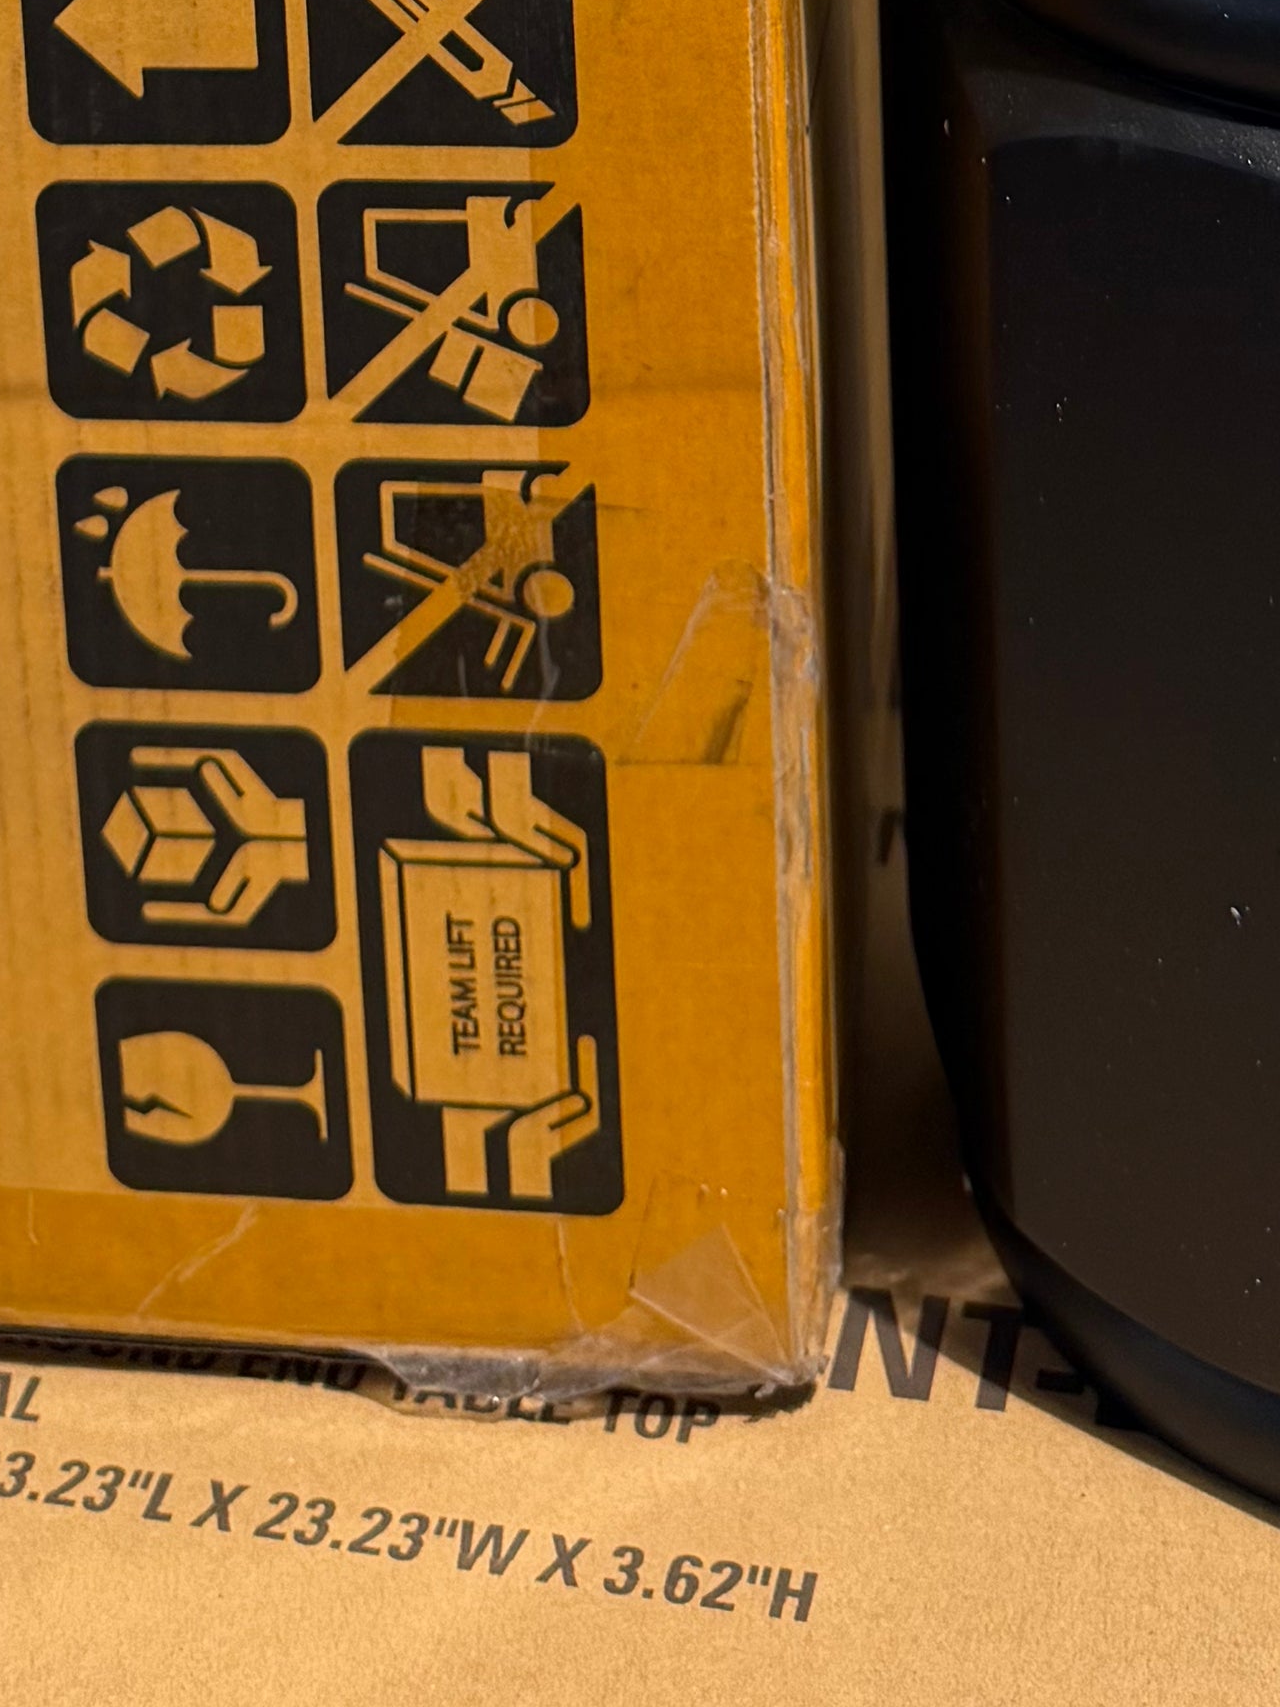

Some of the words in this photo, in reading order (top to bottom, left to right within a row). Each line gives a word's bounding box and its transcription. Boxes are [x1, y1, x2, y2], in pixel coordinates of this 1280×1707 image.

[446, 913, 475, 970] LIFT
[450, 979, 480, 1055] TEAM
[492, 917, 526, 1056] REQUIRED
[603, 1386, 721, 1444] TOP
[191, 1481, 248, 1531] X
[254, 1493, 529, 1575] 23.23"W
[536, 1535, 590, 1587] X
[604, 1547, 817, 1622] 3.62"H
